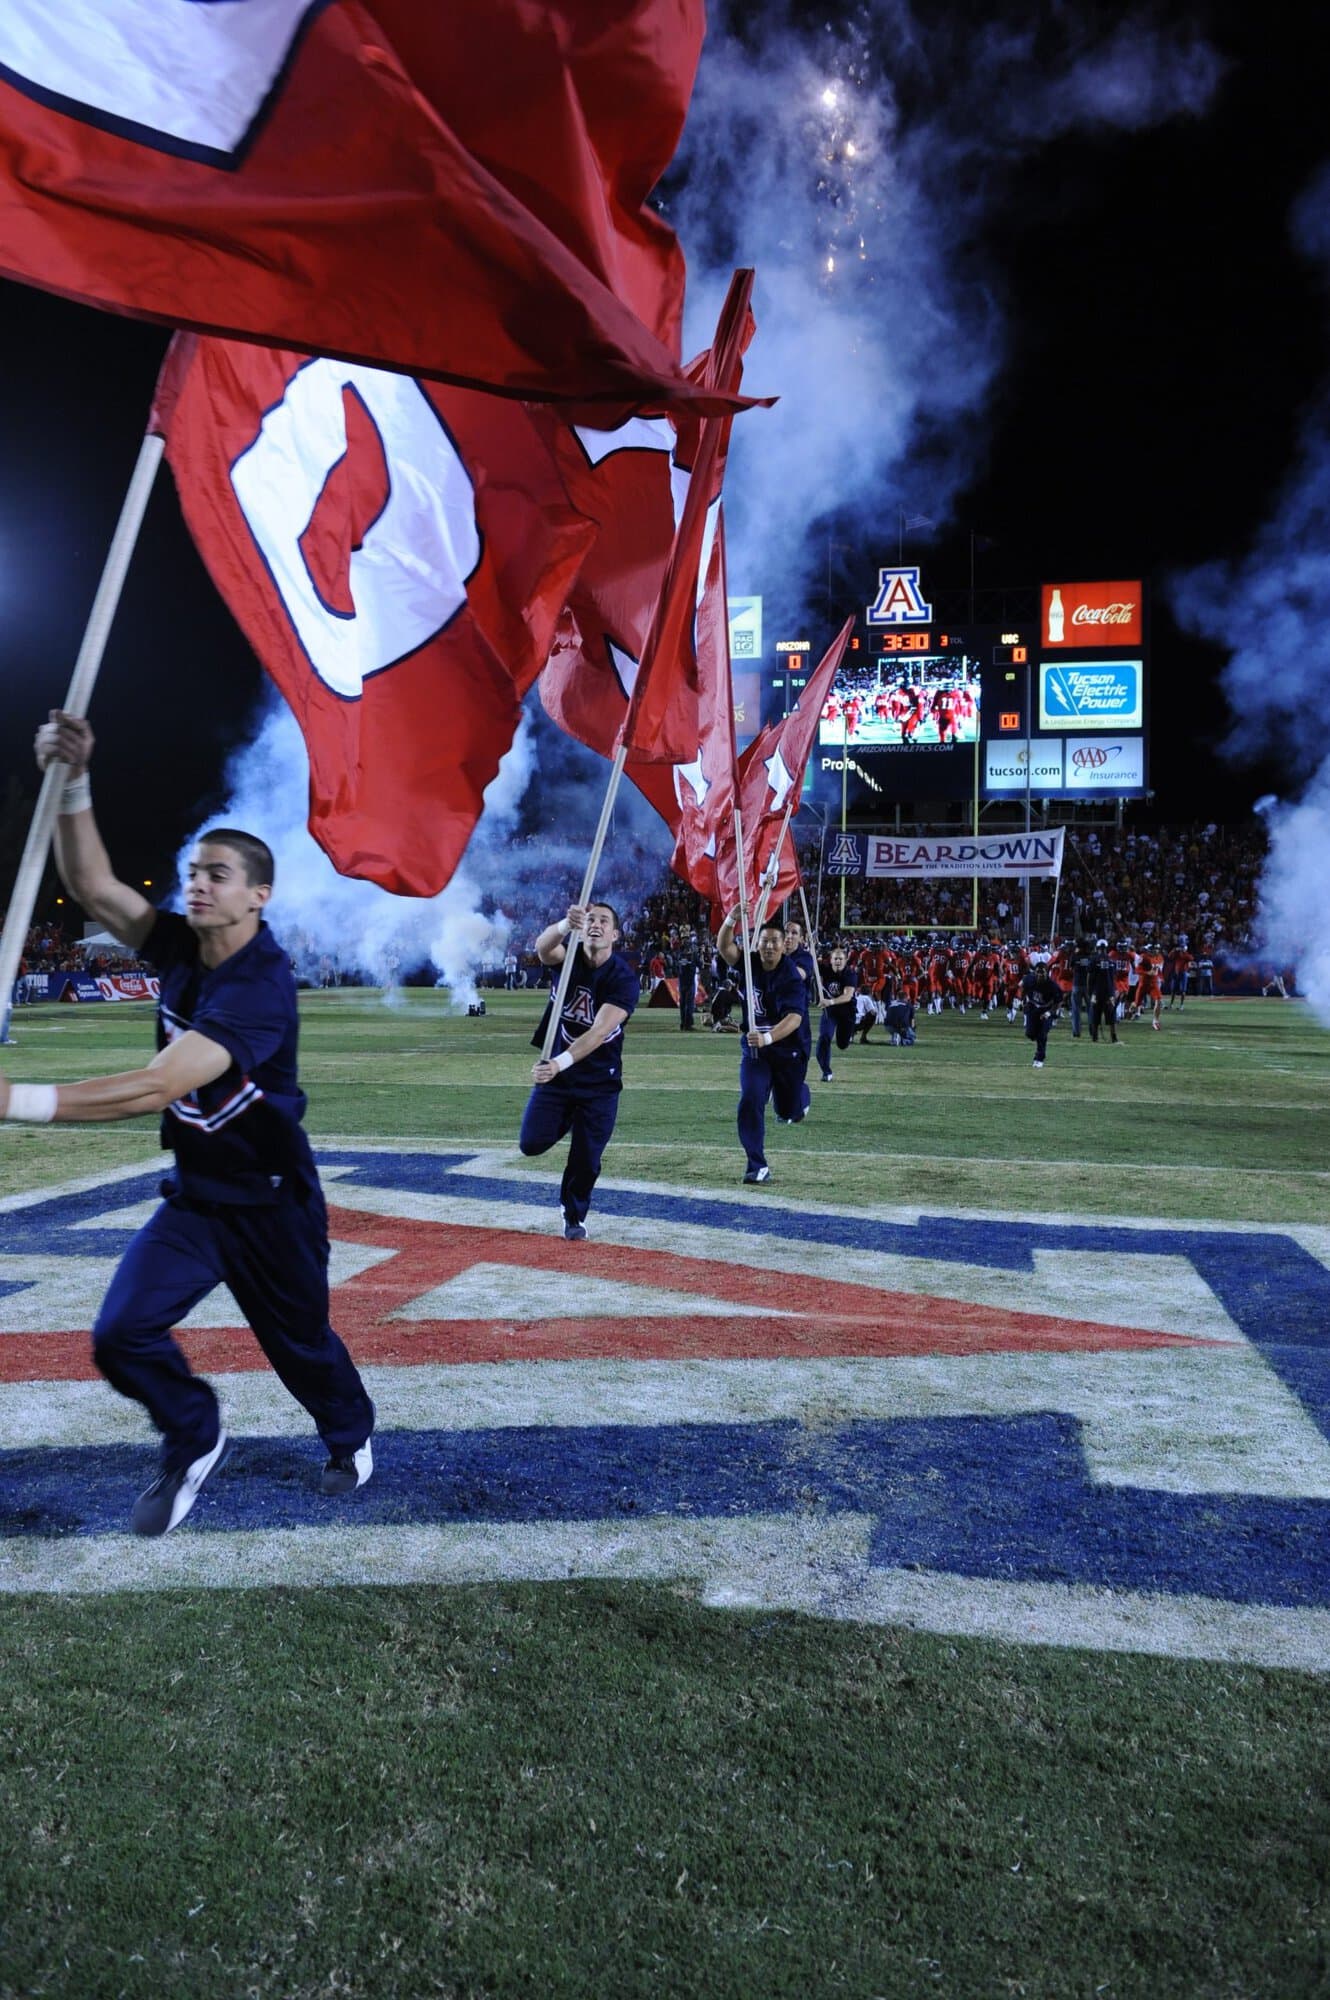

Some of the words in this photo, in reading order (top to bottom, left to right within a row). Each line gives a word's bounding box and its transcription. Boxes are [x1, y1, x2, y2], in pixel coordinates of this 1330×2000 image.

[866, 566, 932, 625] A
[1072, 603, 1136, 625] Coca-Cola
[776, 641, 810, 651] ARIZONA
[851, 638, 859, 649] 3
[883, 633, 929, 651] 3:30
[940, 635, 948, 647] 3
[1013, 648, 1026, 662] 0
[789, 655, 801, 669] 0
[1068, 672, 1115, 685] Tucson
[1072, 684, 1128, 697] Electric
[1078, 697, 1128, 709] Power
[1076, 747, 1105, 768] AAA
[1090, 770, 1138, 780] Insurance
[560, 984, 596, 1027] A
